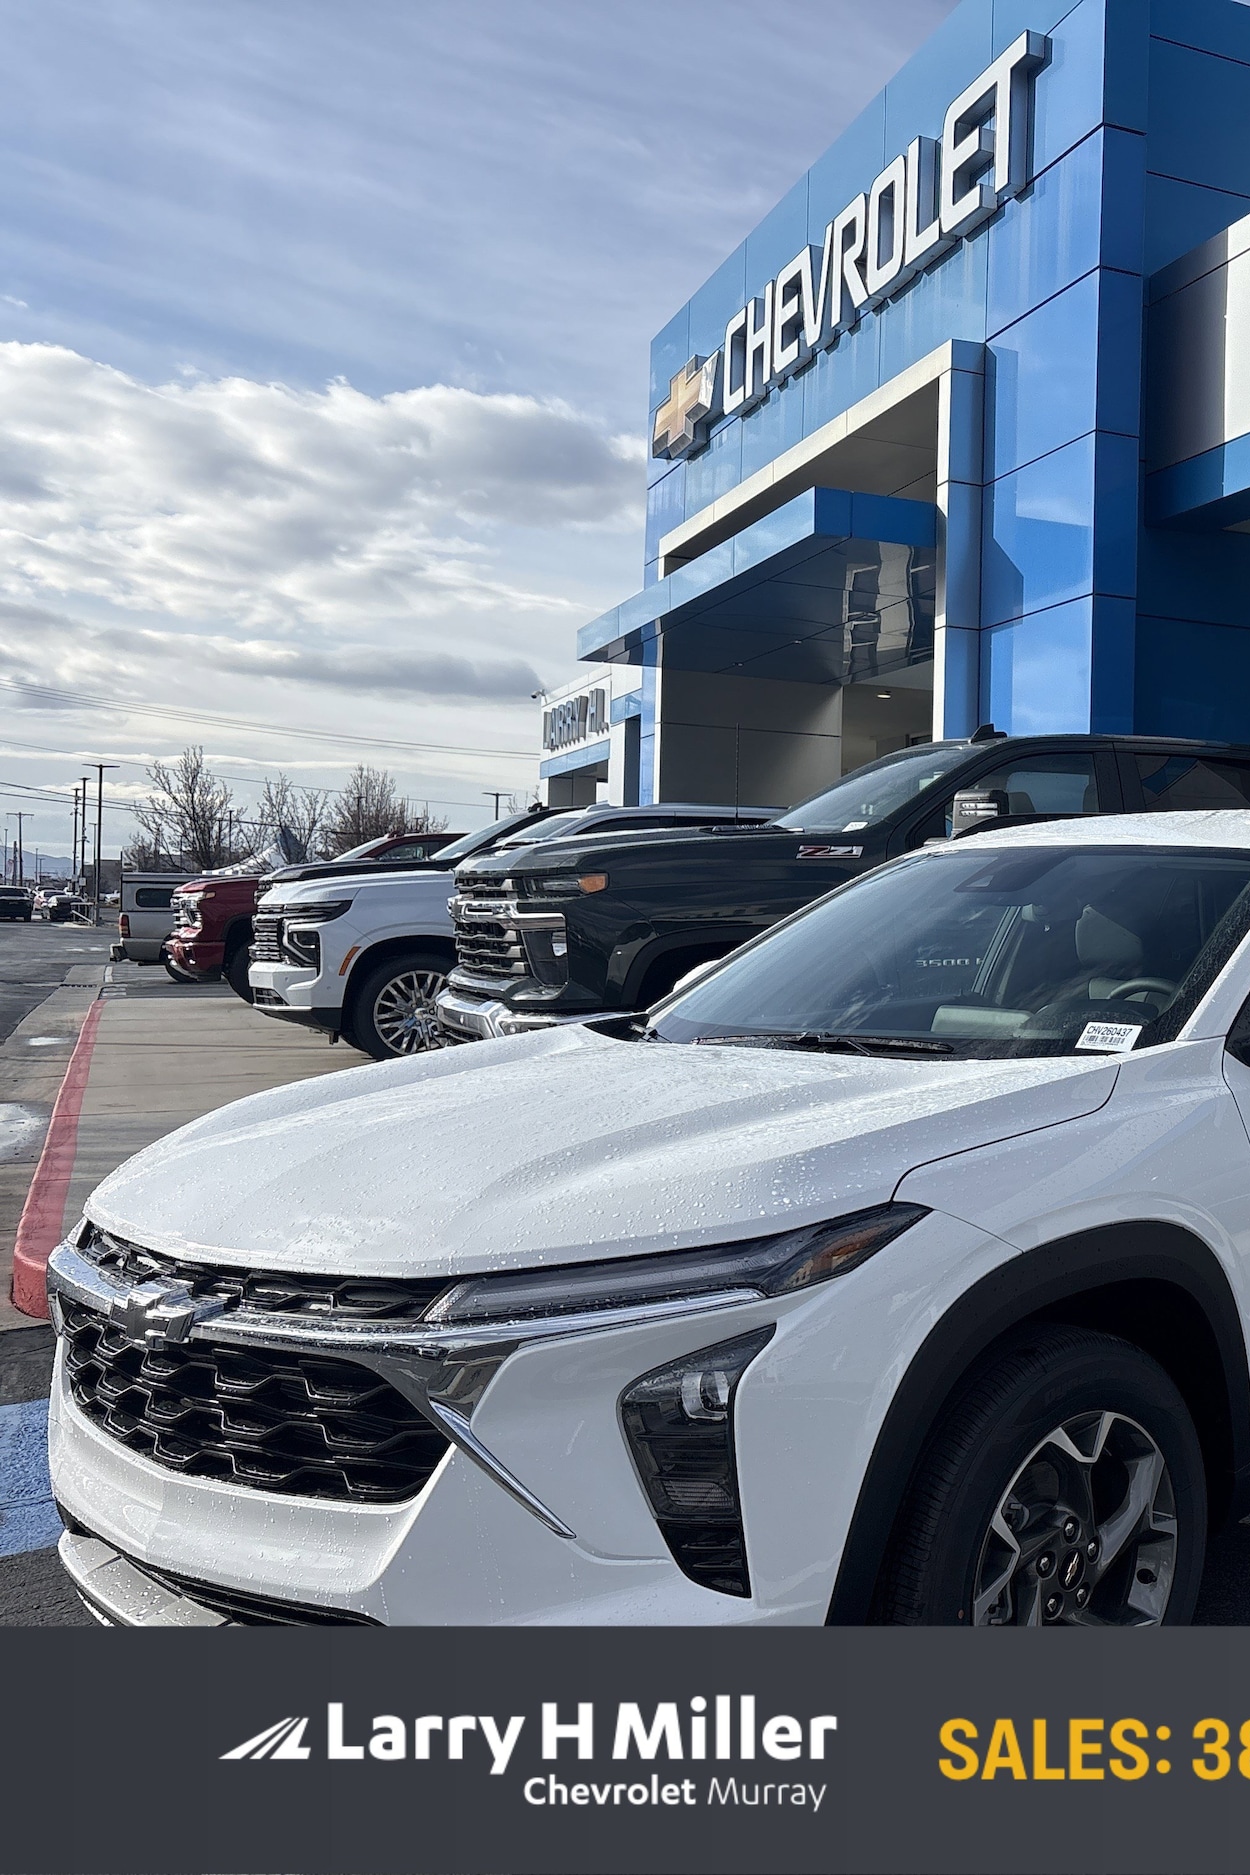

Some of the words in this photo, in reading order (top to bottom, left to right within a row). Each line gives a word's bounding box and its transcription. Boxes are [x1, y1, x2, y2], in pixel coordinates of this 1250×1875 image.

[723, 29, 1052, 417] CHEVROLET
[916, 958, 970, 968] 3500
[1086, 1025, 1133, 1038] CHV260437
